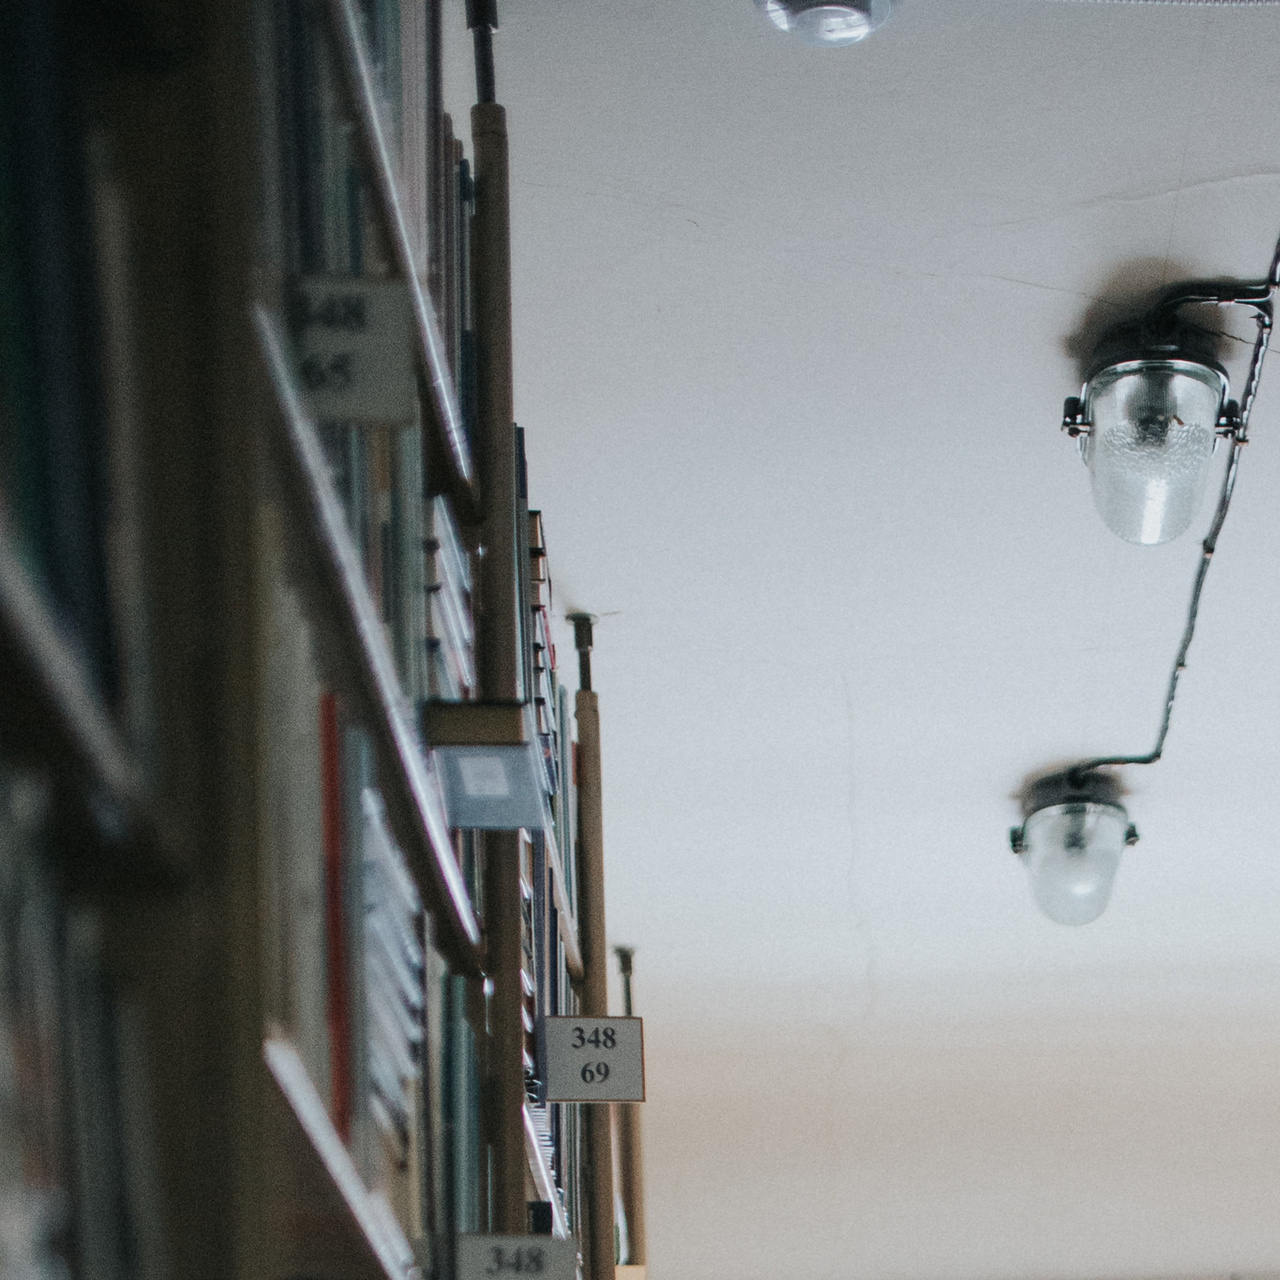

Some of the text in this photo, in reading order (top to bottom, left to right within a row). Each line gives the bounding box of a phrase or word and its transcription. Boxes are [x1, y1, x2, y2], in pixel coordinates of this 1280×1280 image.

[572, 1027, 617, 1051] 348
[580, 1061, 611, 1085] 69
[485, 1246, 545, 1275] 348
